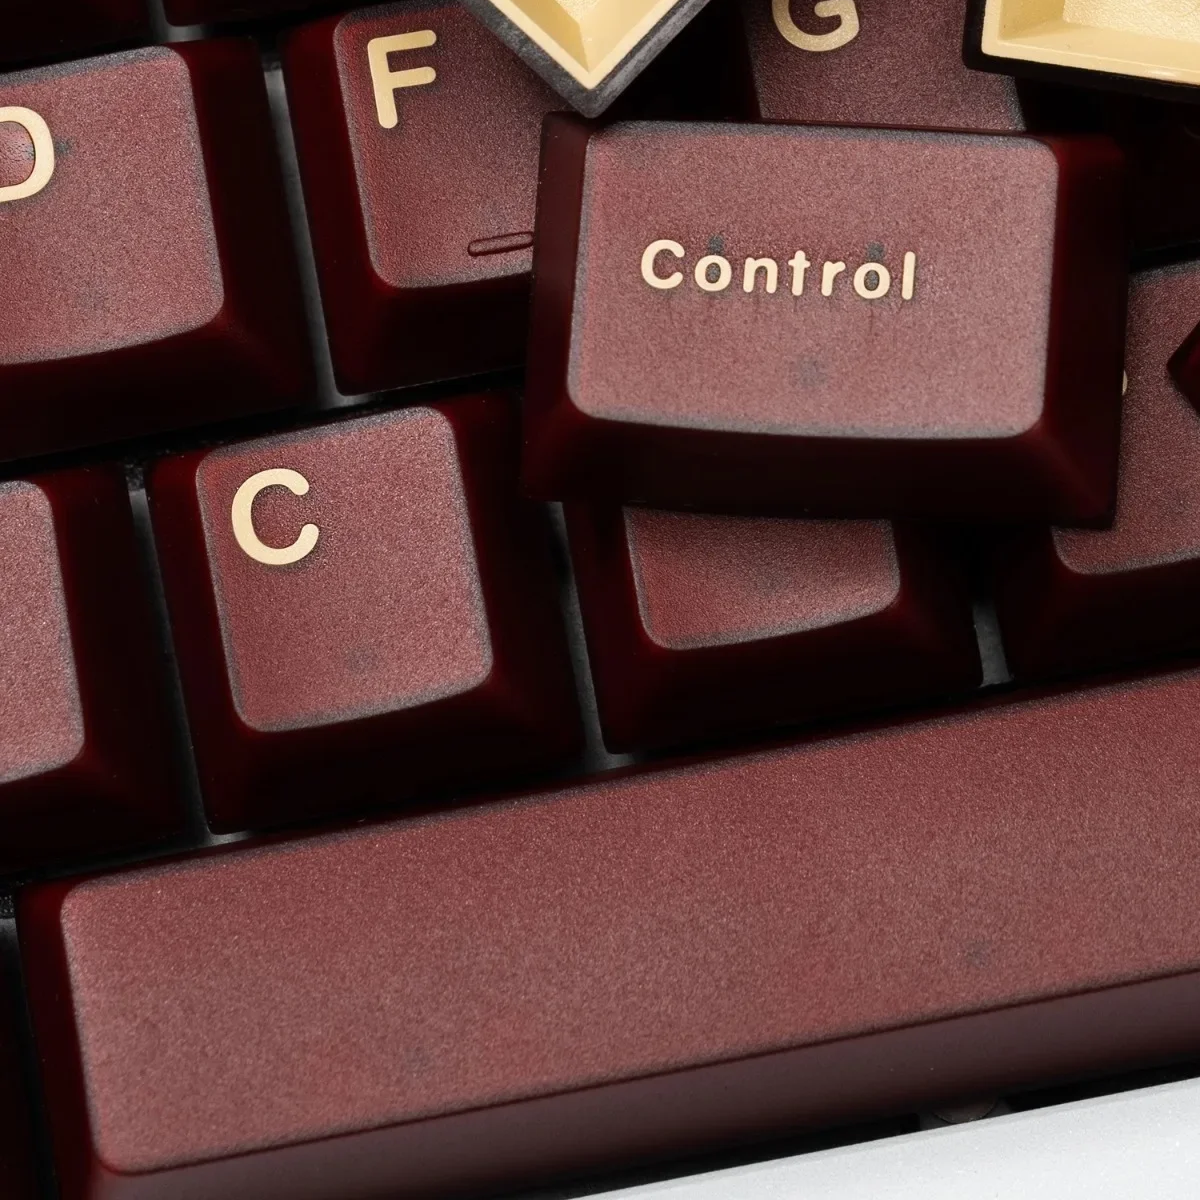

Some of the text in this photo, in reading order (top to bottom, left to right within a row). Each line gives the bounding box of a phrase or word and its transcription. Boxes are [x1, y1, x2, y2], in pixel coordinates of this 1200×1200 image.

[366, 28, 438, 130] F
[639, 237, 917, 302] Control
[230, 467, 321, 567] C
